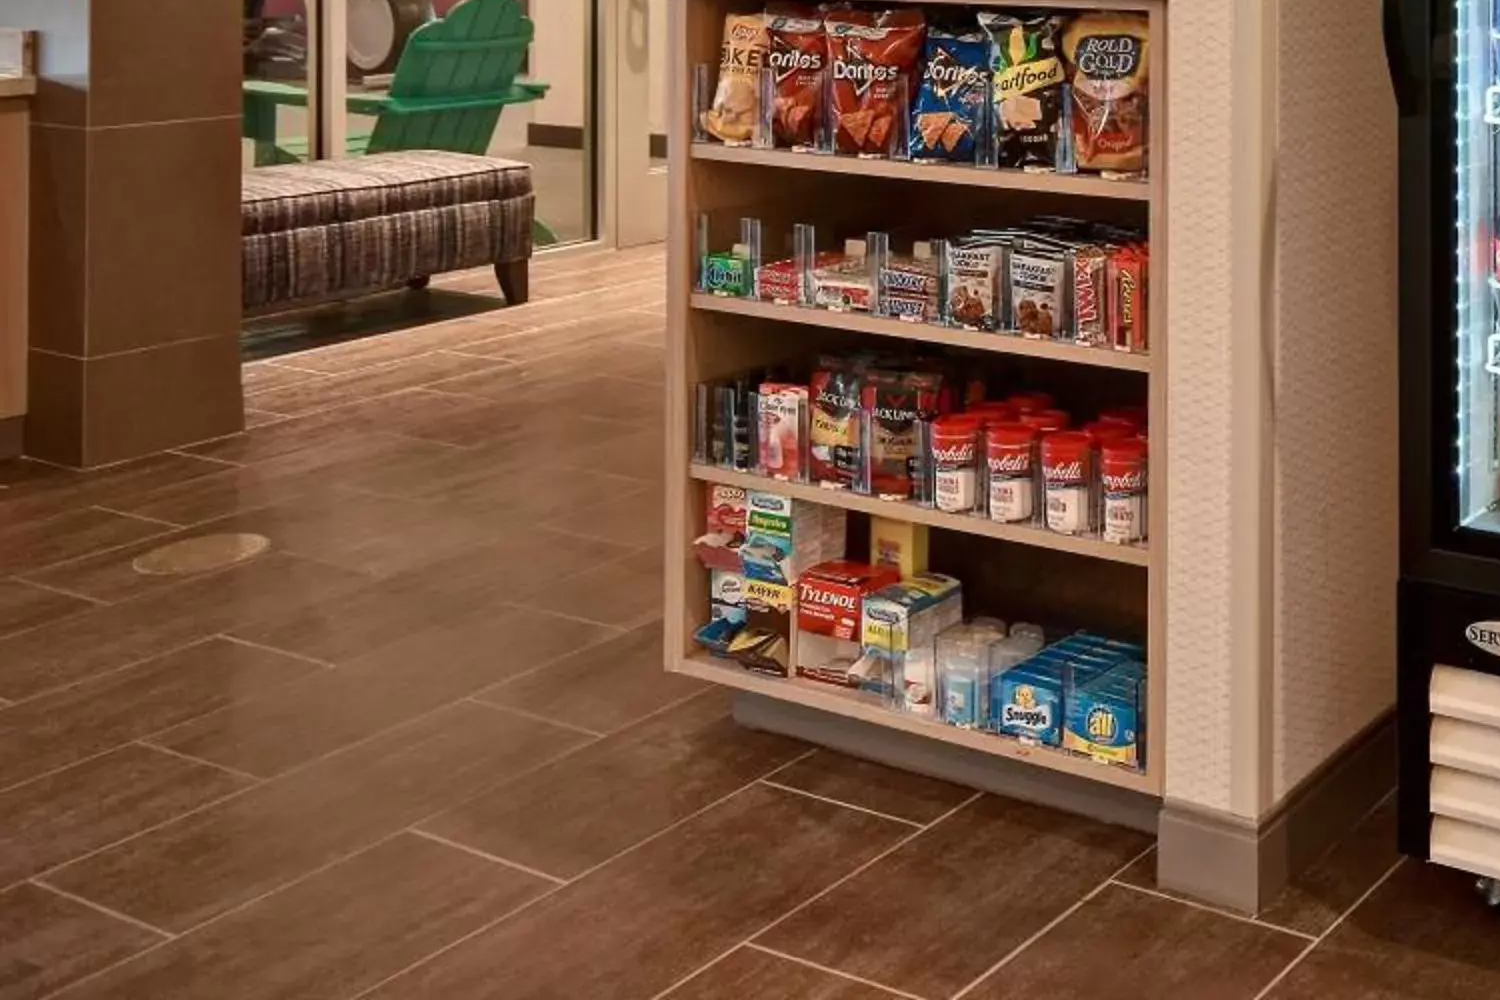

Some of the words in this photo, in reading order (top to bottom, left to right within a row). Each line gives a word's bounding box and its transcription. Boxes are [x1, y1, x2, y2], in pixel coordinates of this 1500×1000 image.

[1086, 36, 1134, 53] ROLD
[769, 51, 821, 70] oritos
[1078, 52, 1135, 74] GOLD
[833, 61, 899, 81] Doritos
[996, 63, 1058, 93] artfood
[799, 582, 858, 609] TYLENOL
[1005, 707, 1048, 726] Snuggle
